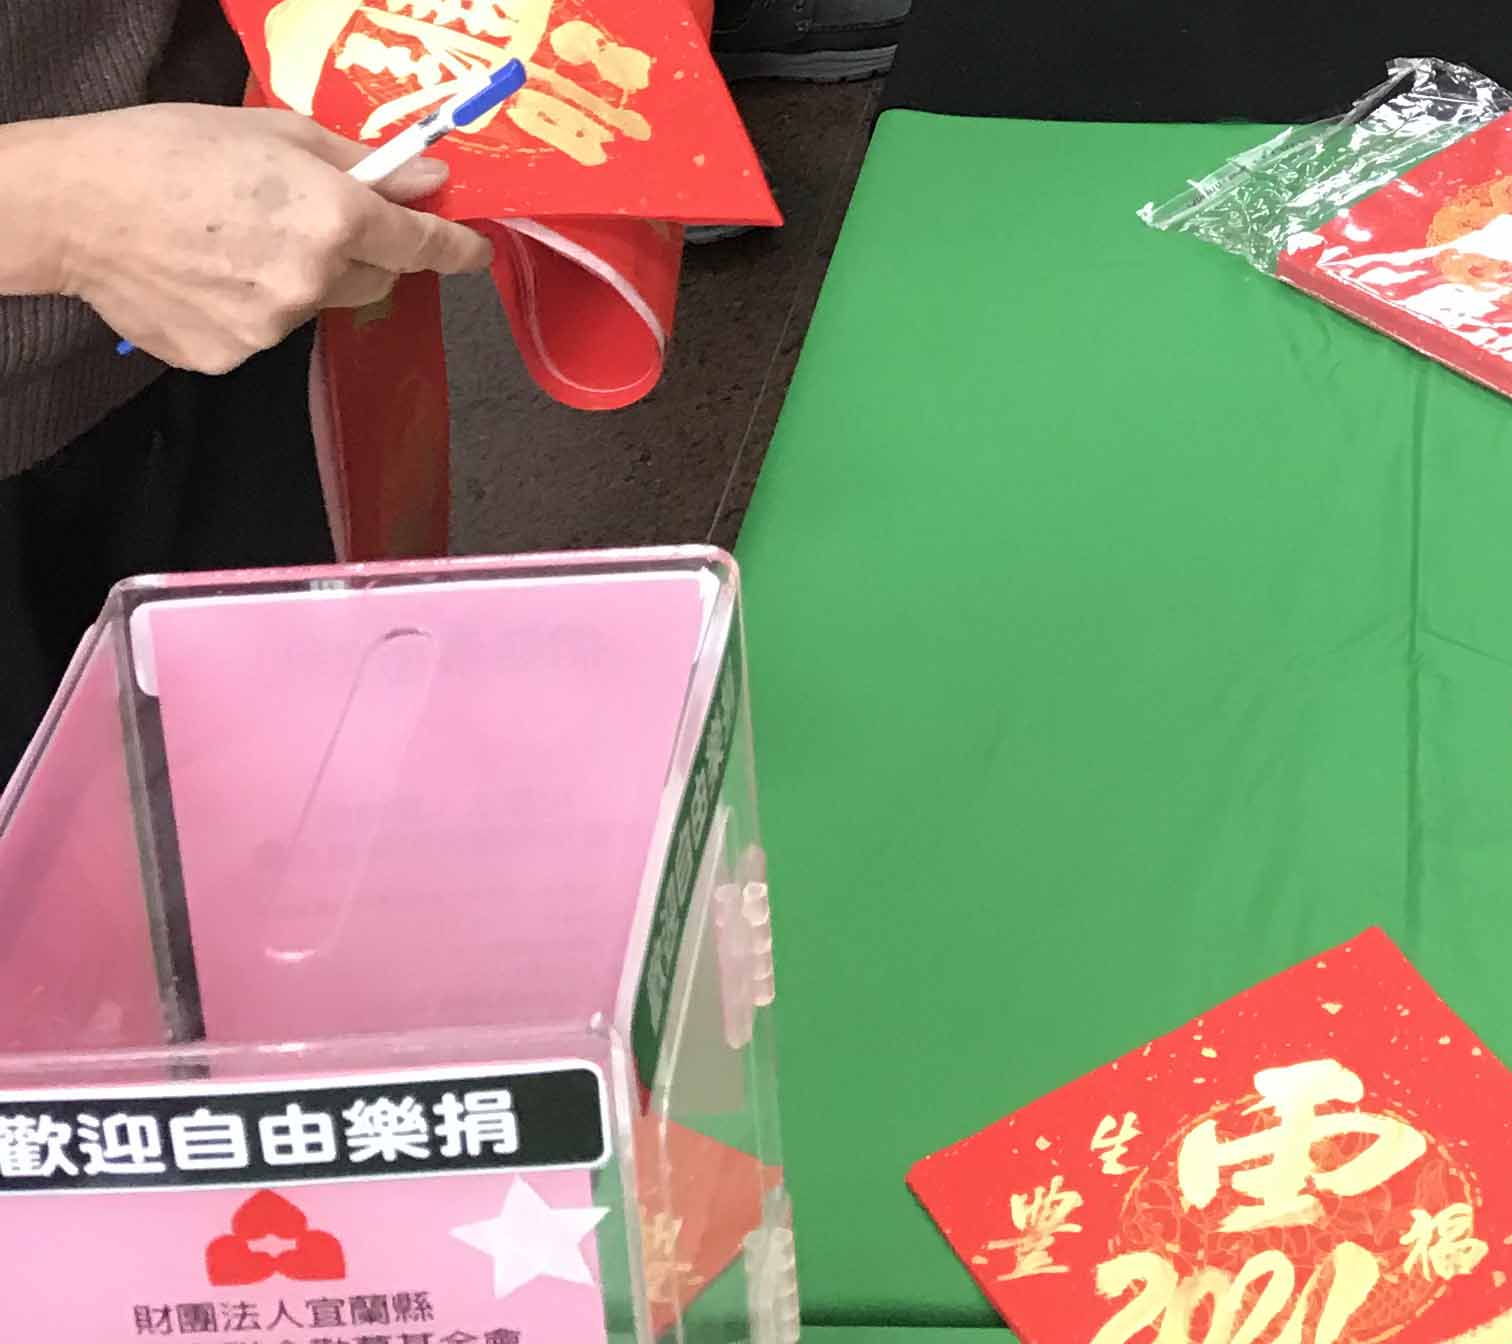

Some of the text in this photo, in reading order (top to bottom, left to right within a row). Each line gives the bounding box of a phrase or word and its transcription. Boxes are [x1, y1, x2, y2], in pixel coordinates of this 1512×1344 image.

[0, 1089, 519, 1178] 歡迎自由樂捐
[133, 1290, 434, 1335] 財團法人宜蘭縣
